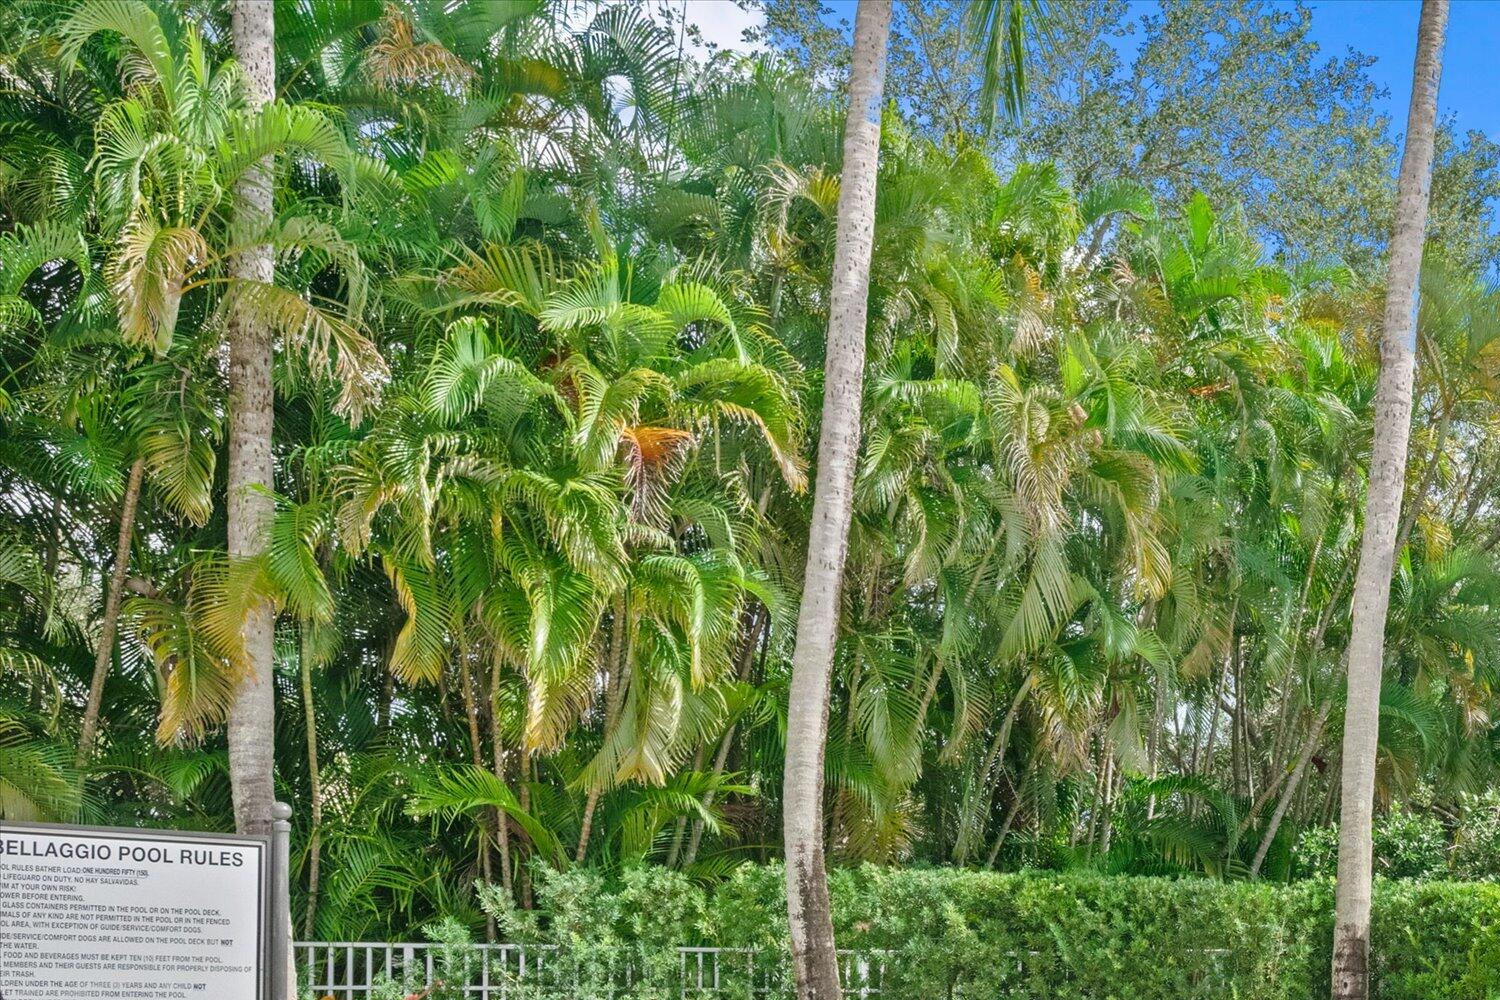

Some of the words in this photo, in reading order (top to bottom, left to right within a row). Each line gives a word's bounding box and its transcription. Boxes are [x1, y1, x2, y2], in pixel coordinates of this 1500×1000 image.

[119, 846, 173, 864] POOL
[180, 849, 243, 867] RULES
[12, 864, 34, 872] RULES
[35, 865, 62, 873] BATHER
[81, 867, 94, 875] ONE
[95, 867, 121, 876] HUNDRED
[121, 869, 136, 877] FIFTY
[20, 883, 40, 891] YOUR
[41, 884, 58, 892] OWN
[22, 893, 49, 901] BEFORE
[2, 901, 25, 909] GLASS
[130, 906, 148, 914] POOL
[184, 908, 201, 916] POOL
[48, 912, 65, 920] KIND
[32, 921, 50, 929] WITH
[78, 934, 97, 942] DOGS
[98, 935, 111, 943] ARE
[113, 936, 144, 944] ALLOWED
[169, 937, 187, 945] POOL
[220, 938, 233, 946] NOT
[3, 952, 23, 960] FOOD
[25, 952, 39, 960] AND
[80, 953, 99, 961] MUST
[111, 954, 127, 962] KEPT
[129, 954, 142, 962] TEN
[155, 955, 171, 963] FEET
[3, 961, 38, 969] MEMBERS
[55, 962, 75, 970] THEIR
[75, 962, 102, 970] GUESTS
[176, 964, 209, 972] PROPERLY
[25, 980, 49, 988] UNDER
[65, 981, 79, 989] AGE
[121, 982, 143, 990] YEARS
[144, 982, 158, 990] AND
[158, 982, 172, 990] ANY
[172, 982, 192, 990] CHILD
